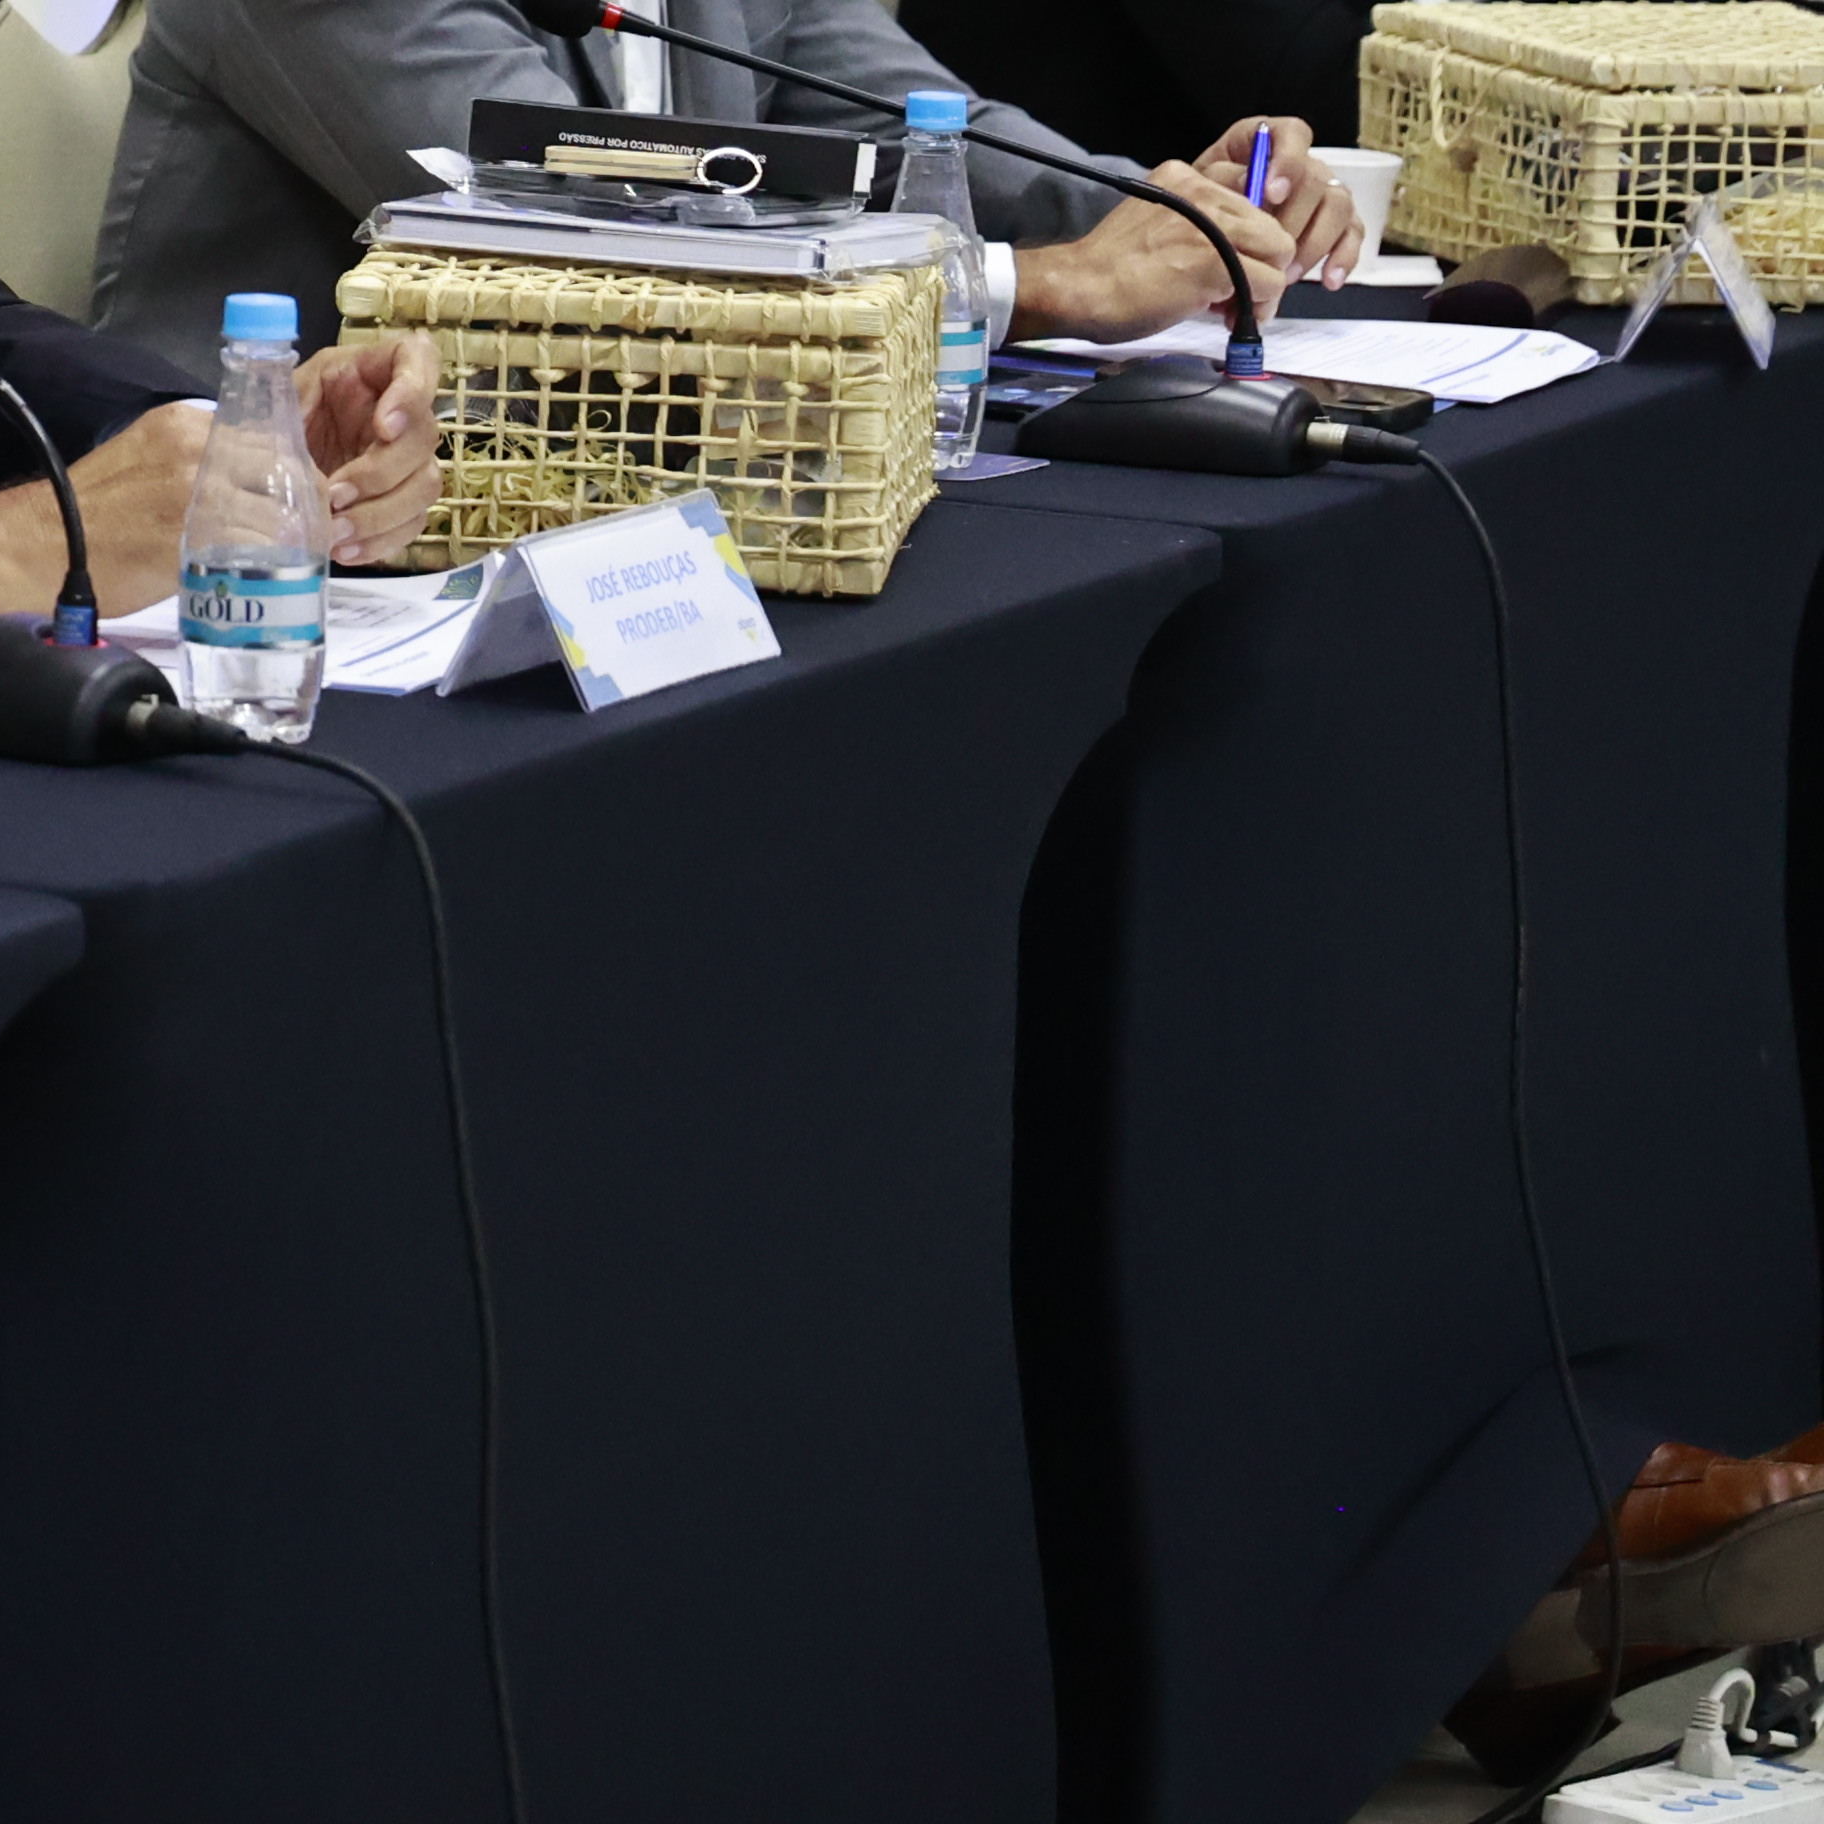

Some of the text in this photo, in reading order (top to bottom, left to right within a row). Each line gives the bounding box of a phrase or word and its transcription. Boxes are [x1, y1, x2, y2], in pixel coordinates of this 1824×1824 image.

[558, 132, 695, 155] AUTOMÁTICO POR PRESSÃO
[585, 550, 697, 603] JOSÉ REBOUÇAS
[189, 593, 264, 623] GOLD
[616, 599, 703, 645] PRODEB/BA
